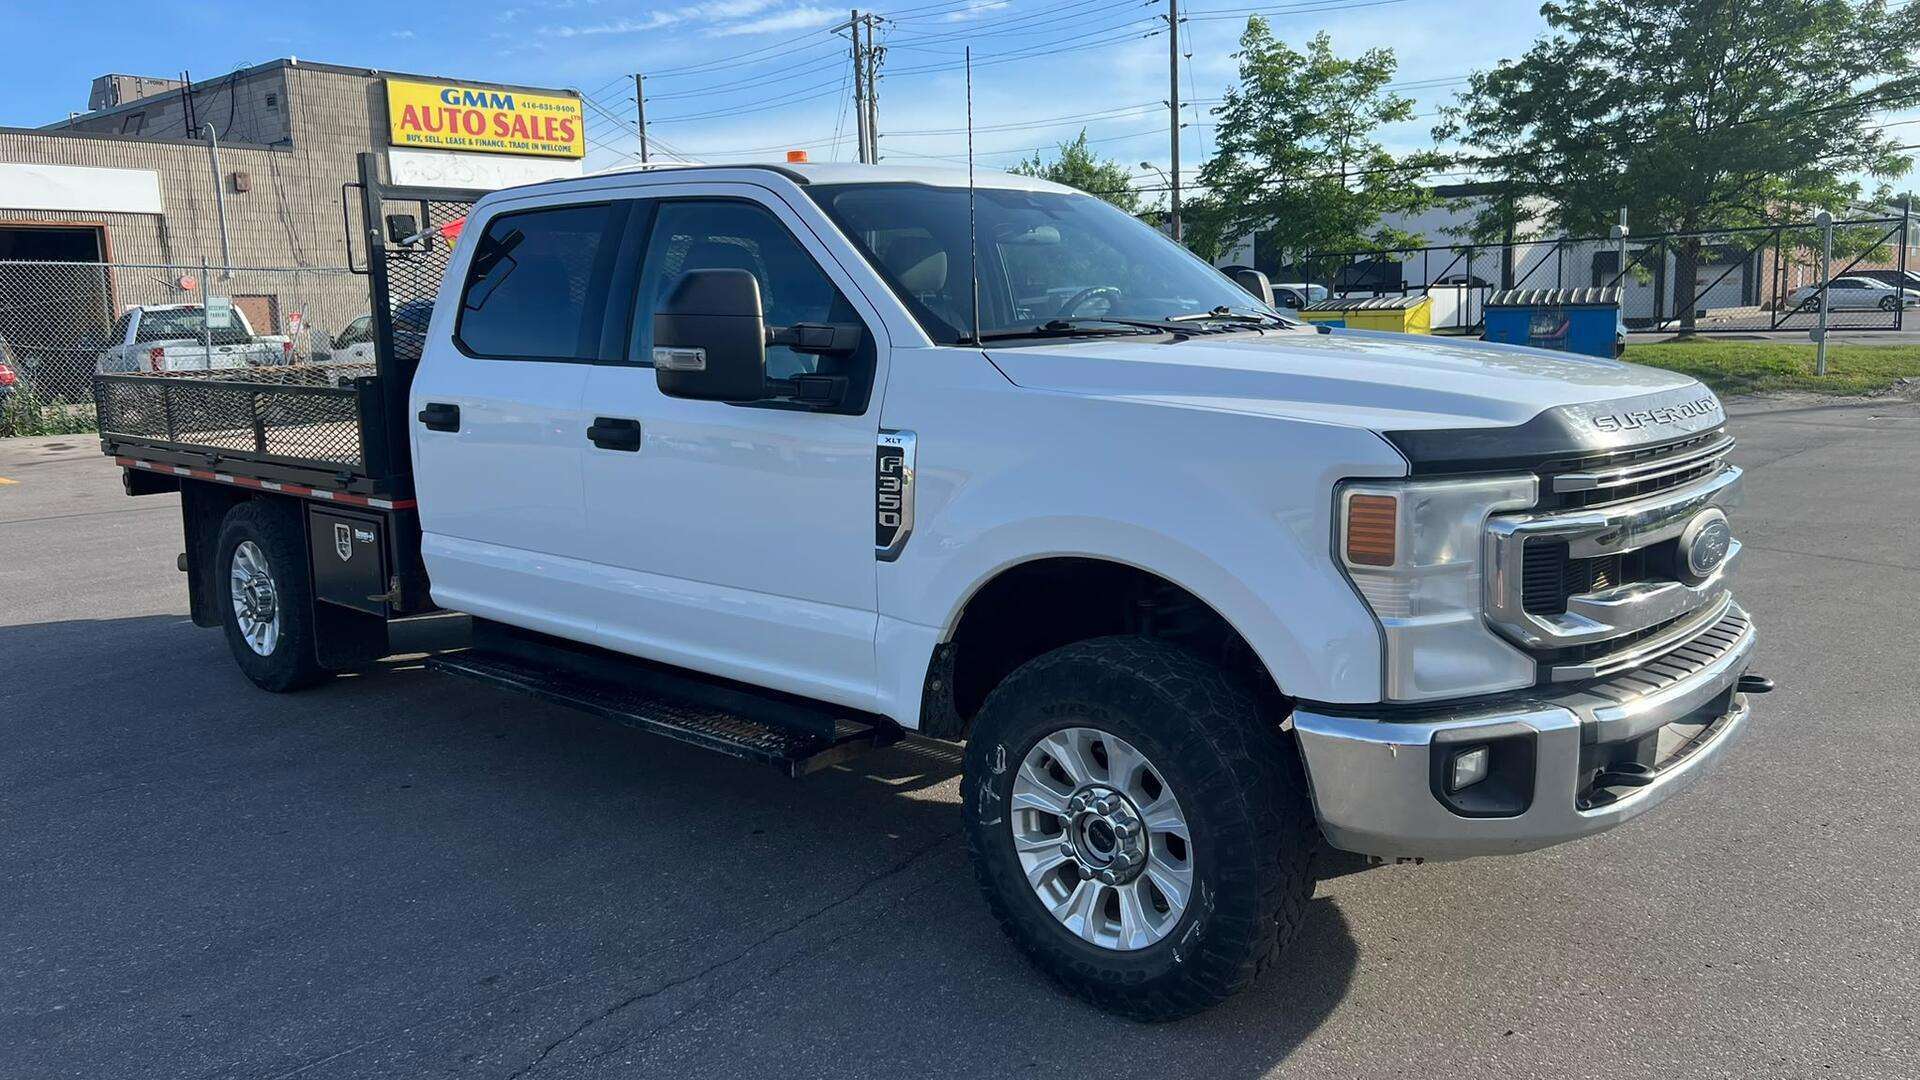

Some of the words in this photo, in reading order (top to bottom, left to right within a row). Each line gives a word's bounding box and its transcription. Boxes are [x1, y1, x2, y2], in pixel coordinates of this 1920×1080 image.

[440, 88, 515, 111] GMM
[400, 104, 487, 136] AUTO
[493, 111, 576, 143] SALES
[446, 137, 466, 146] LEASE
[468, 138, 473, 146] &
[509, 141, 530, 150] TRADE
[531, 142, 539, 151] IN
[540, 143, 572, 153] WELCOME
[879, 456, 903, 526] F350
